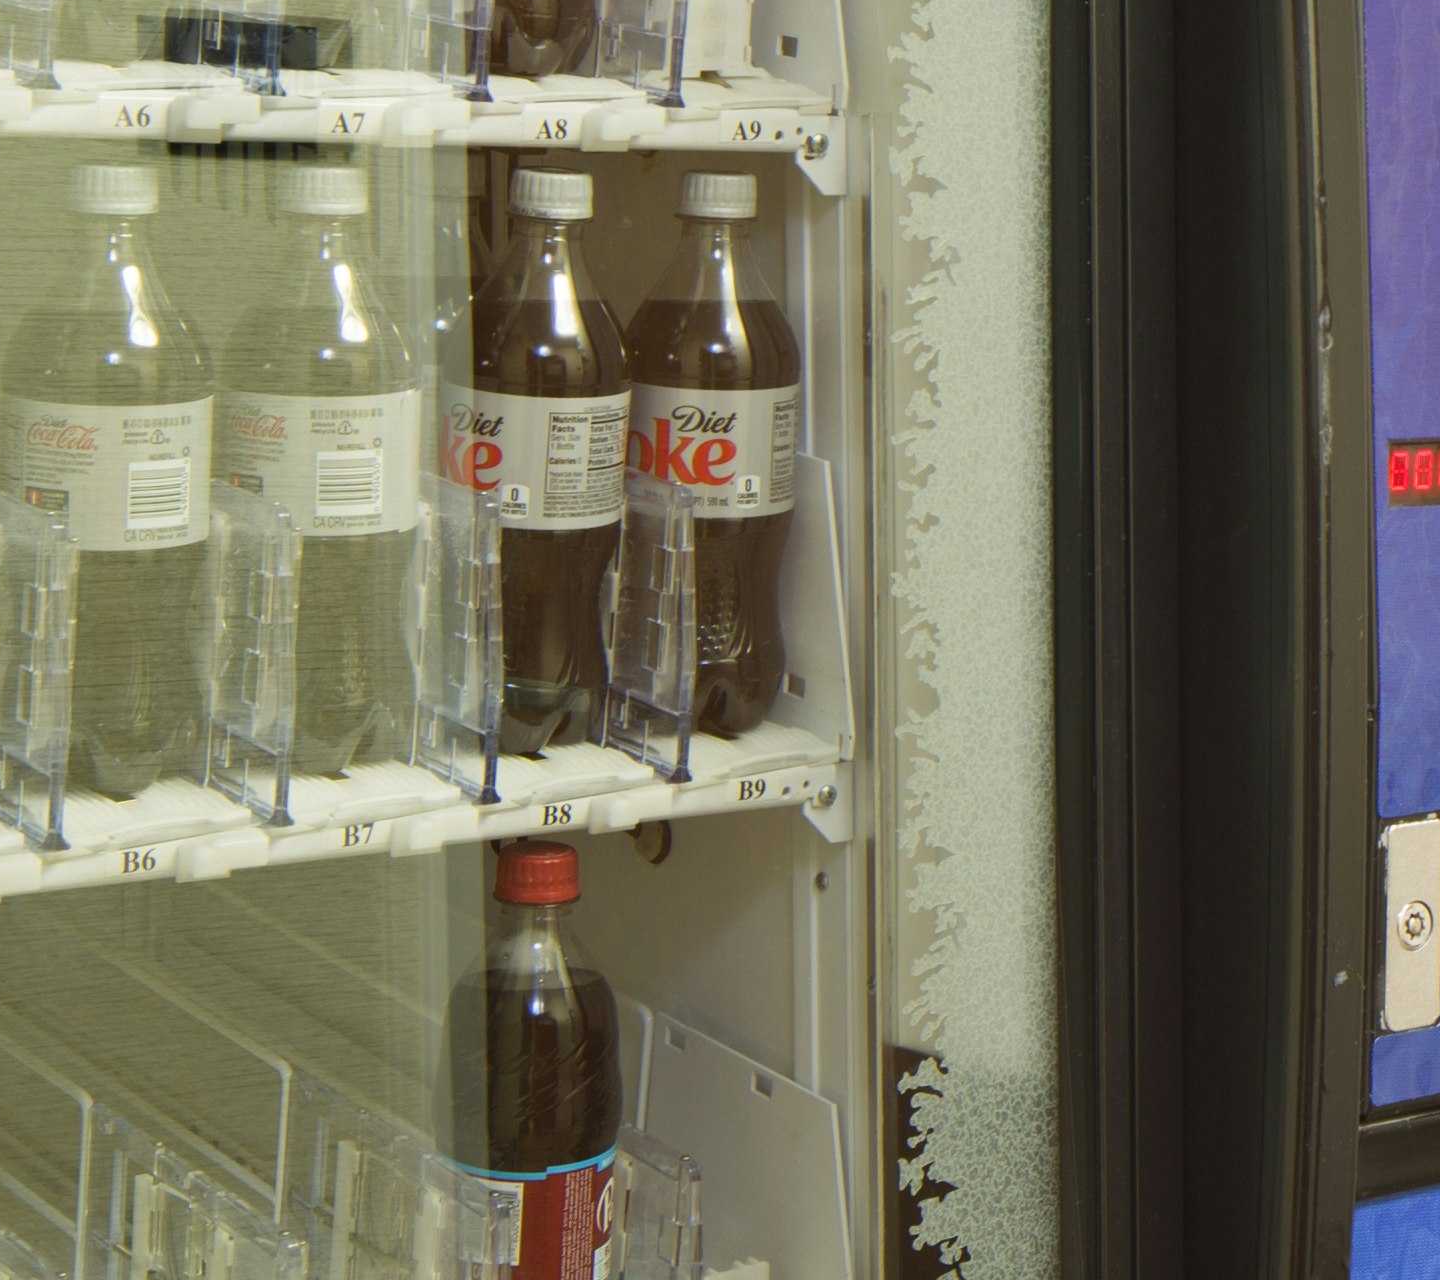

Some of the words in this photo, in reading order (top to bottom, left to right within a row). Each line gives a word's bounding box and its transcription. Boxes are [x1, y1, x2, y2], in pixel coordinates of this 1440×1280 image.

[115, 103, 151, 128] A6
[331, 111, 366, 135] A7
[535, 118, 568, 142] A8
[731, 119, 762, 142] A9
[451, 403, 504, 438] Diet
[672, 405, 737, 433] Diet
[27, 422, 100, 451] Coca-Cola
[510, 487, 519, 502] 0
[745, 479, 751, 492] 0
[737, 779, 767, 802] B9
[540, 803, 572, 827] B8
[341, 822, 375, 848] B7
[120, 848, 157, 874] B6
